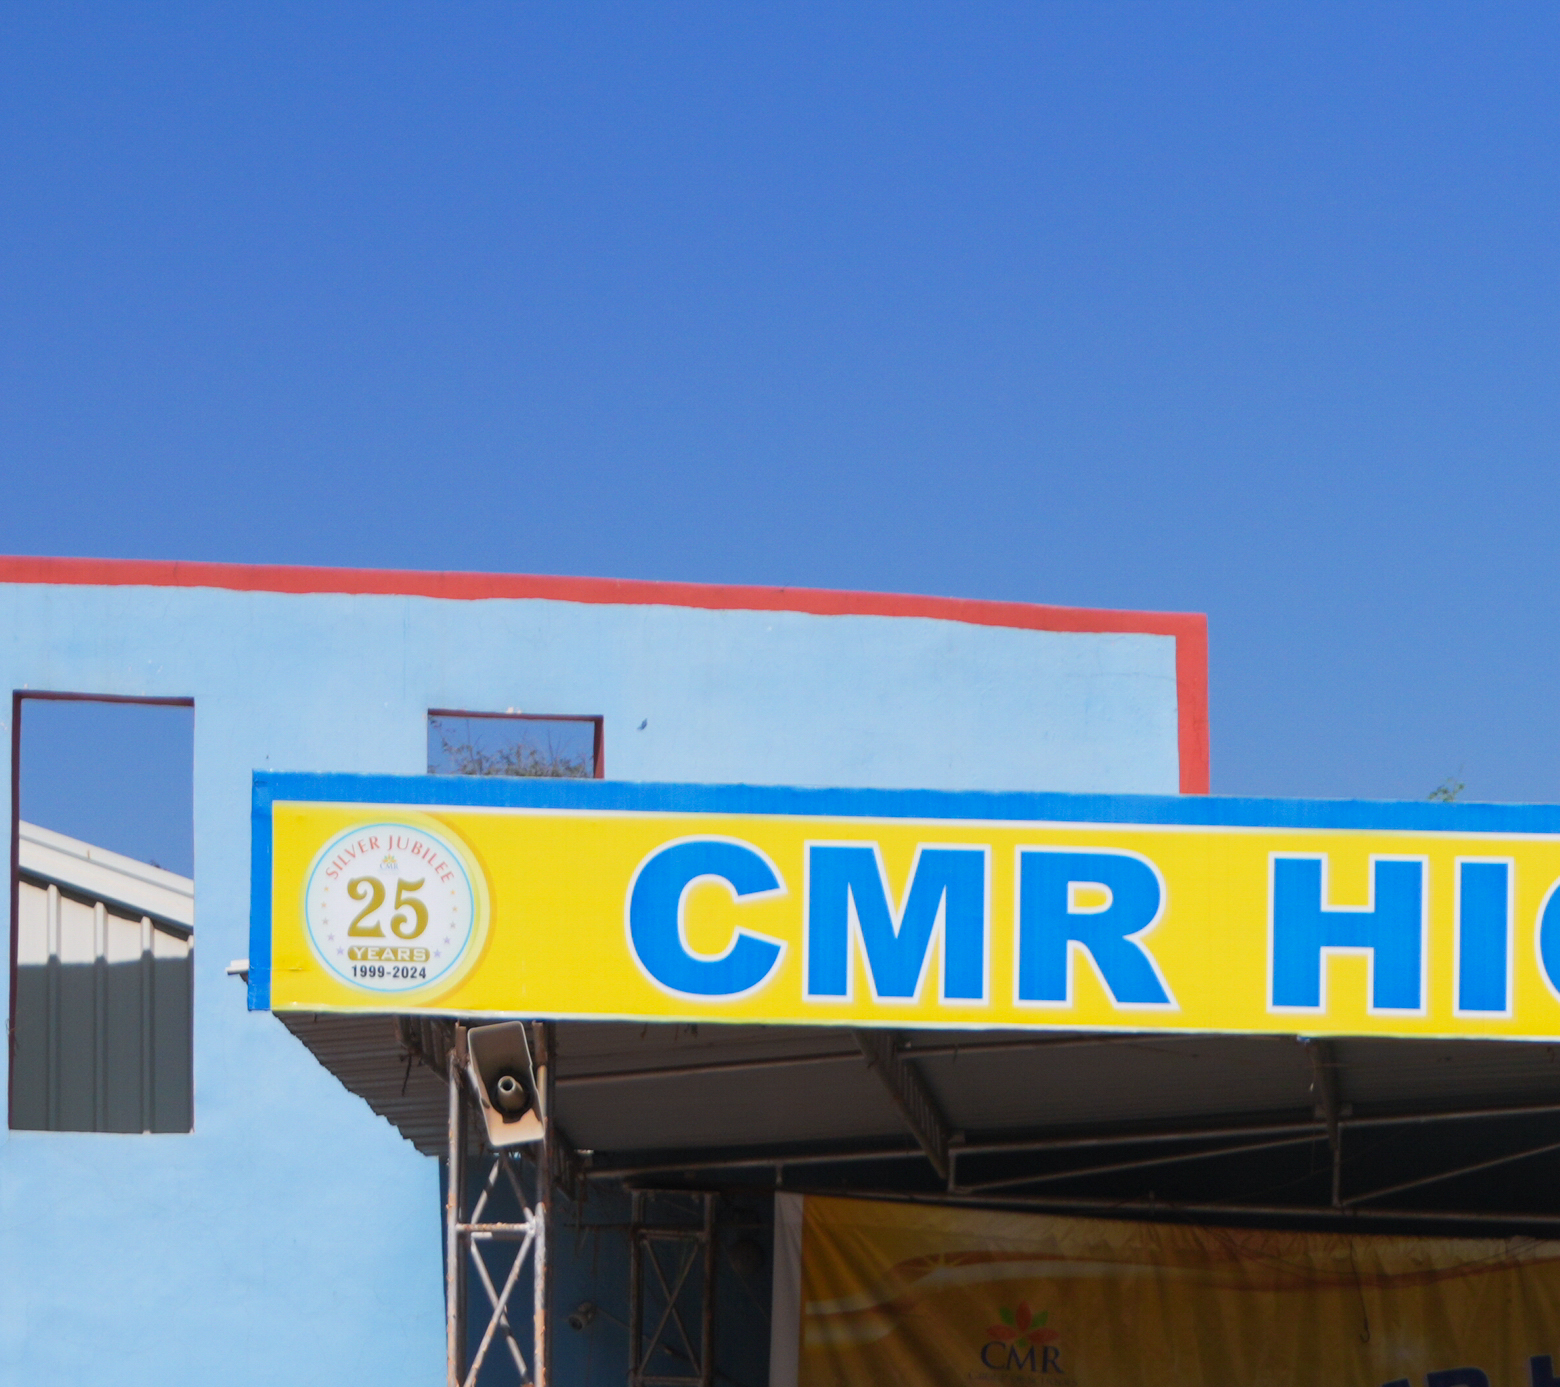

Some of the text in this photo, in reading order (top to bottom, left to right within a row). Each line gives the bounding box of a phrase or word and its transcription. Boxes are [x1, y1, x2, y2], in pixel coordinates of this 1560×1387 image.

[326, 835, 455, 883] SILVER JUBILEE
[347, 876, 429, 940] 25
[630, 839, 1171, 1004] CMR
[351, 965, 427, 979] 1999-2024
[352, 947, 427, 962] YEARS
[980, 1340, 1065, 1374] CMR
